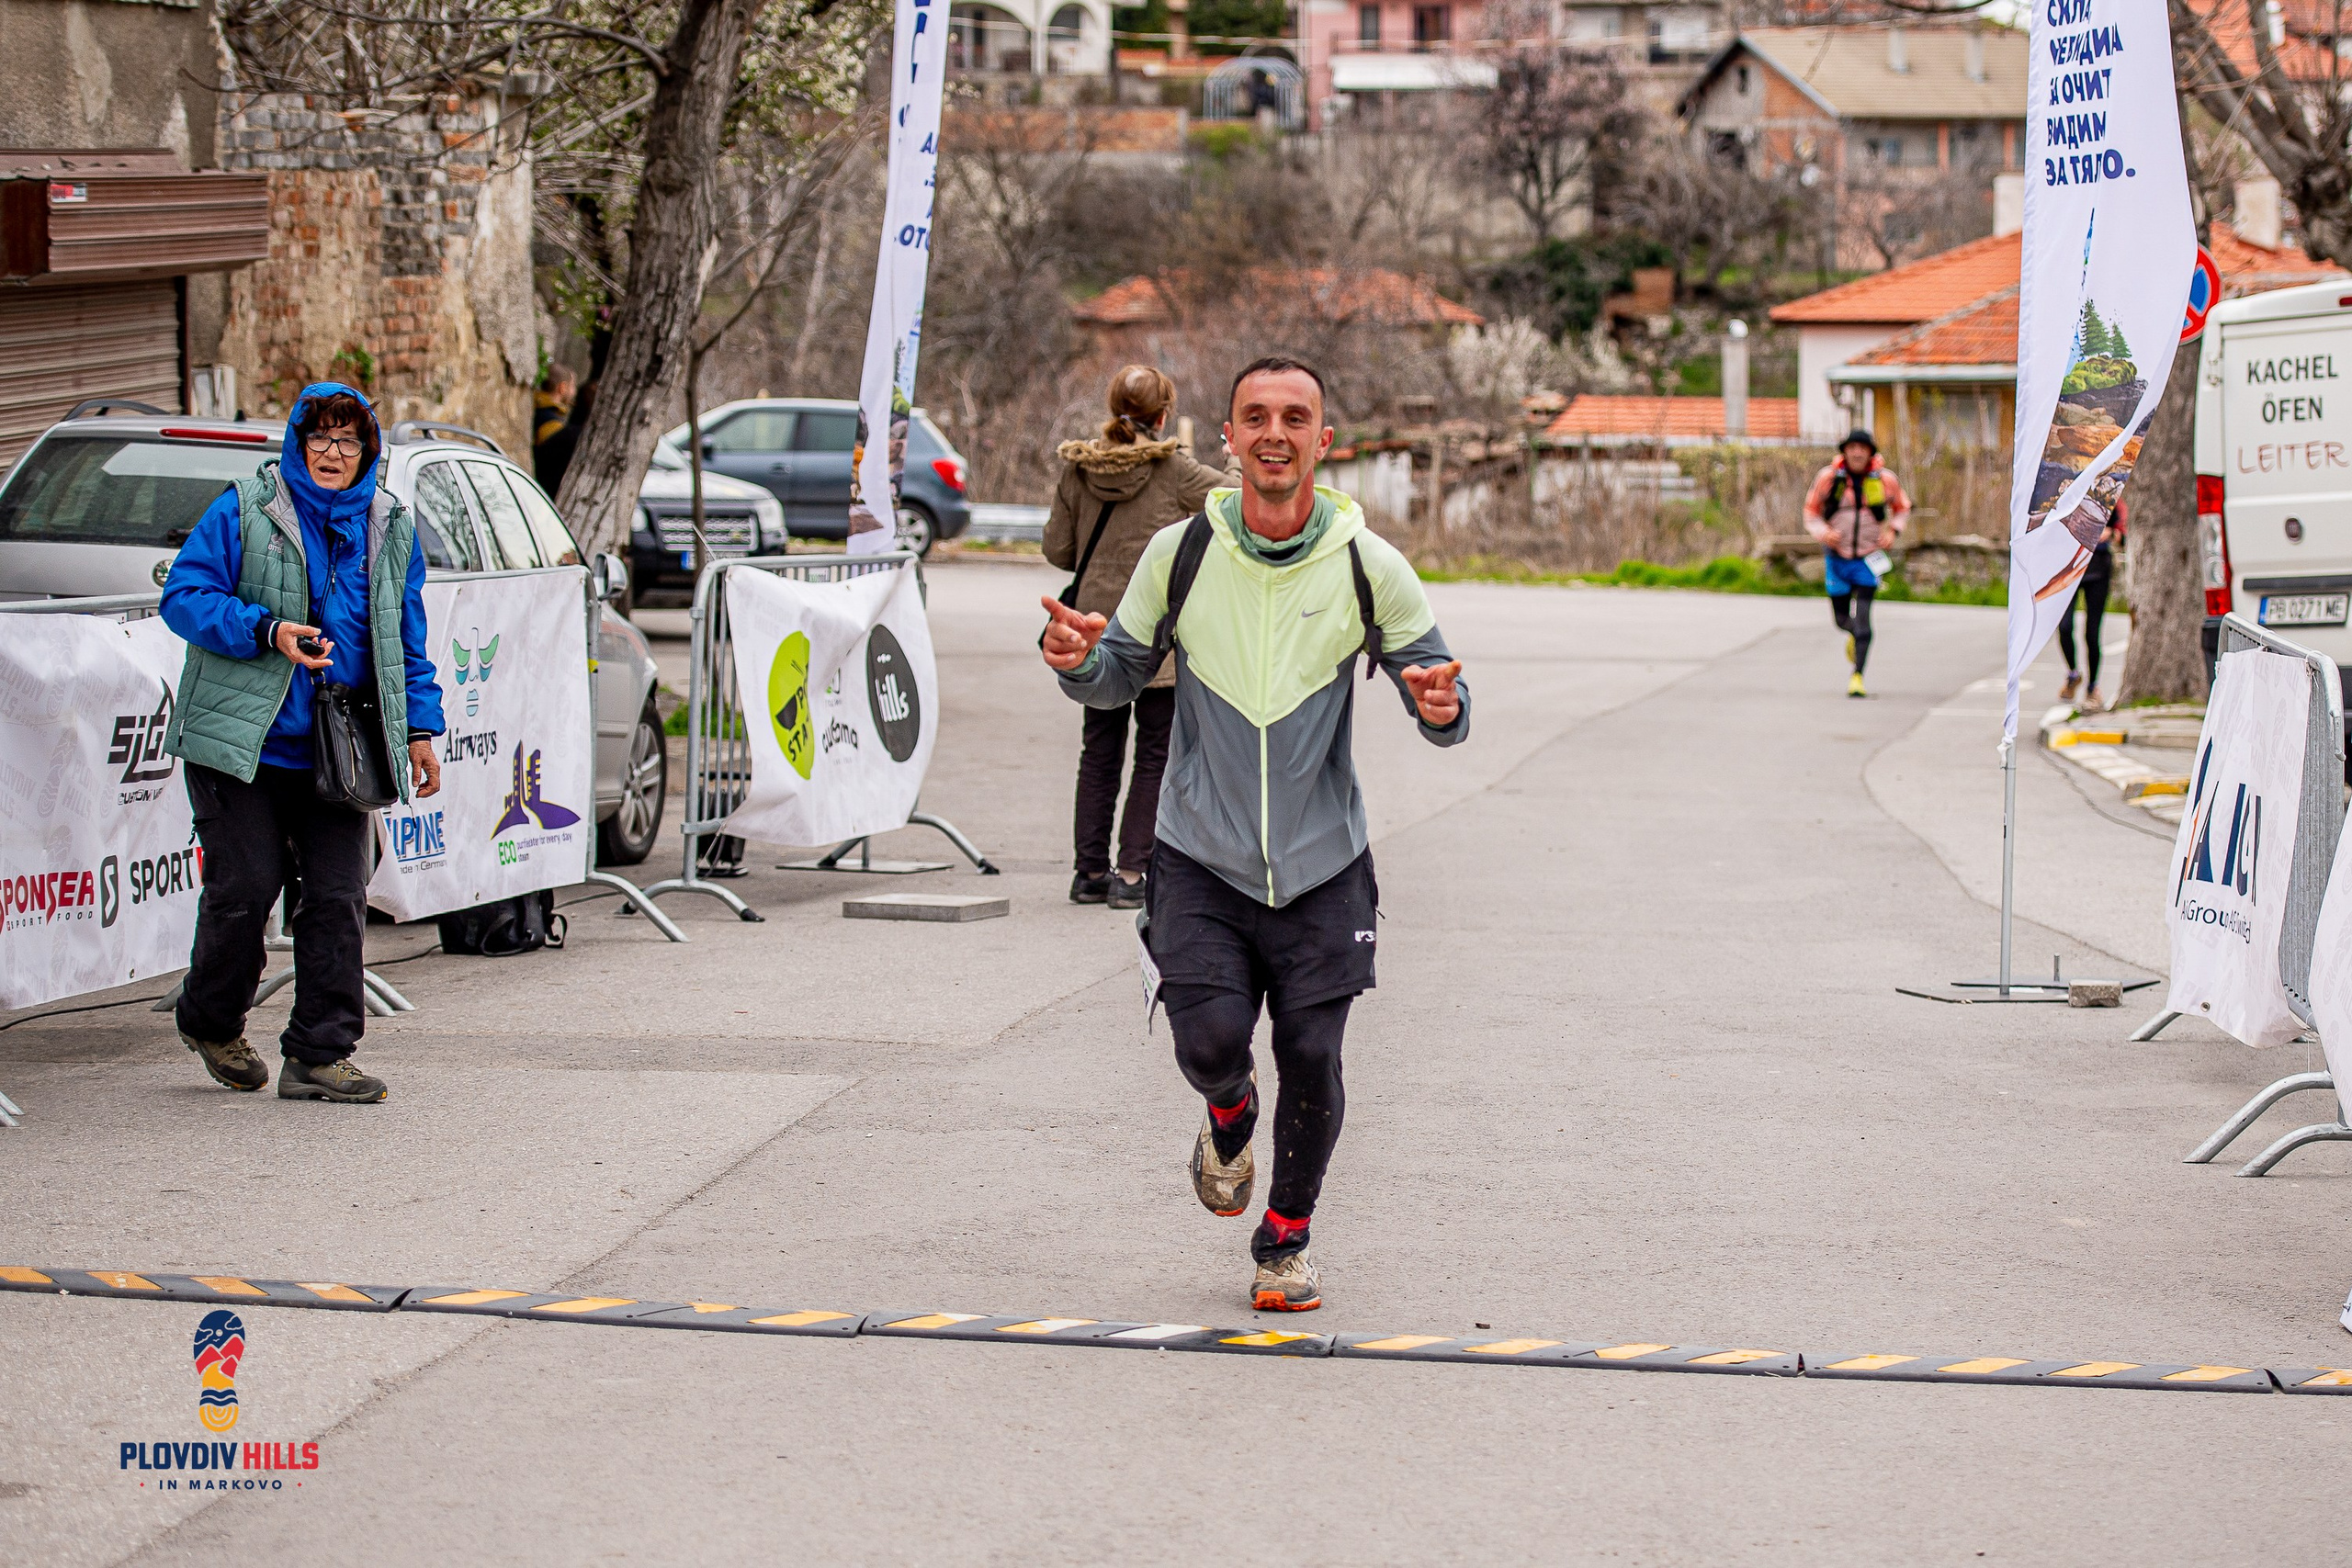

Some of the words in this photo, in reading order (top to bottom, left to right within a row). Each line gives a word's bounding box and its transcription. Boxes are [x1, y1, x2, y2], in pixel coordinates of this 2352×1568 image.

[2247, 354, 2339, 385] KACHEL
[2237, 440, 2350, 473] LEITER
[443, 728, 497, 765] Airways
[498, 840, 517, 866] ECO
[130, 848, 194, 905] SPORT
[57, 911, 93, 922] FOOD
